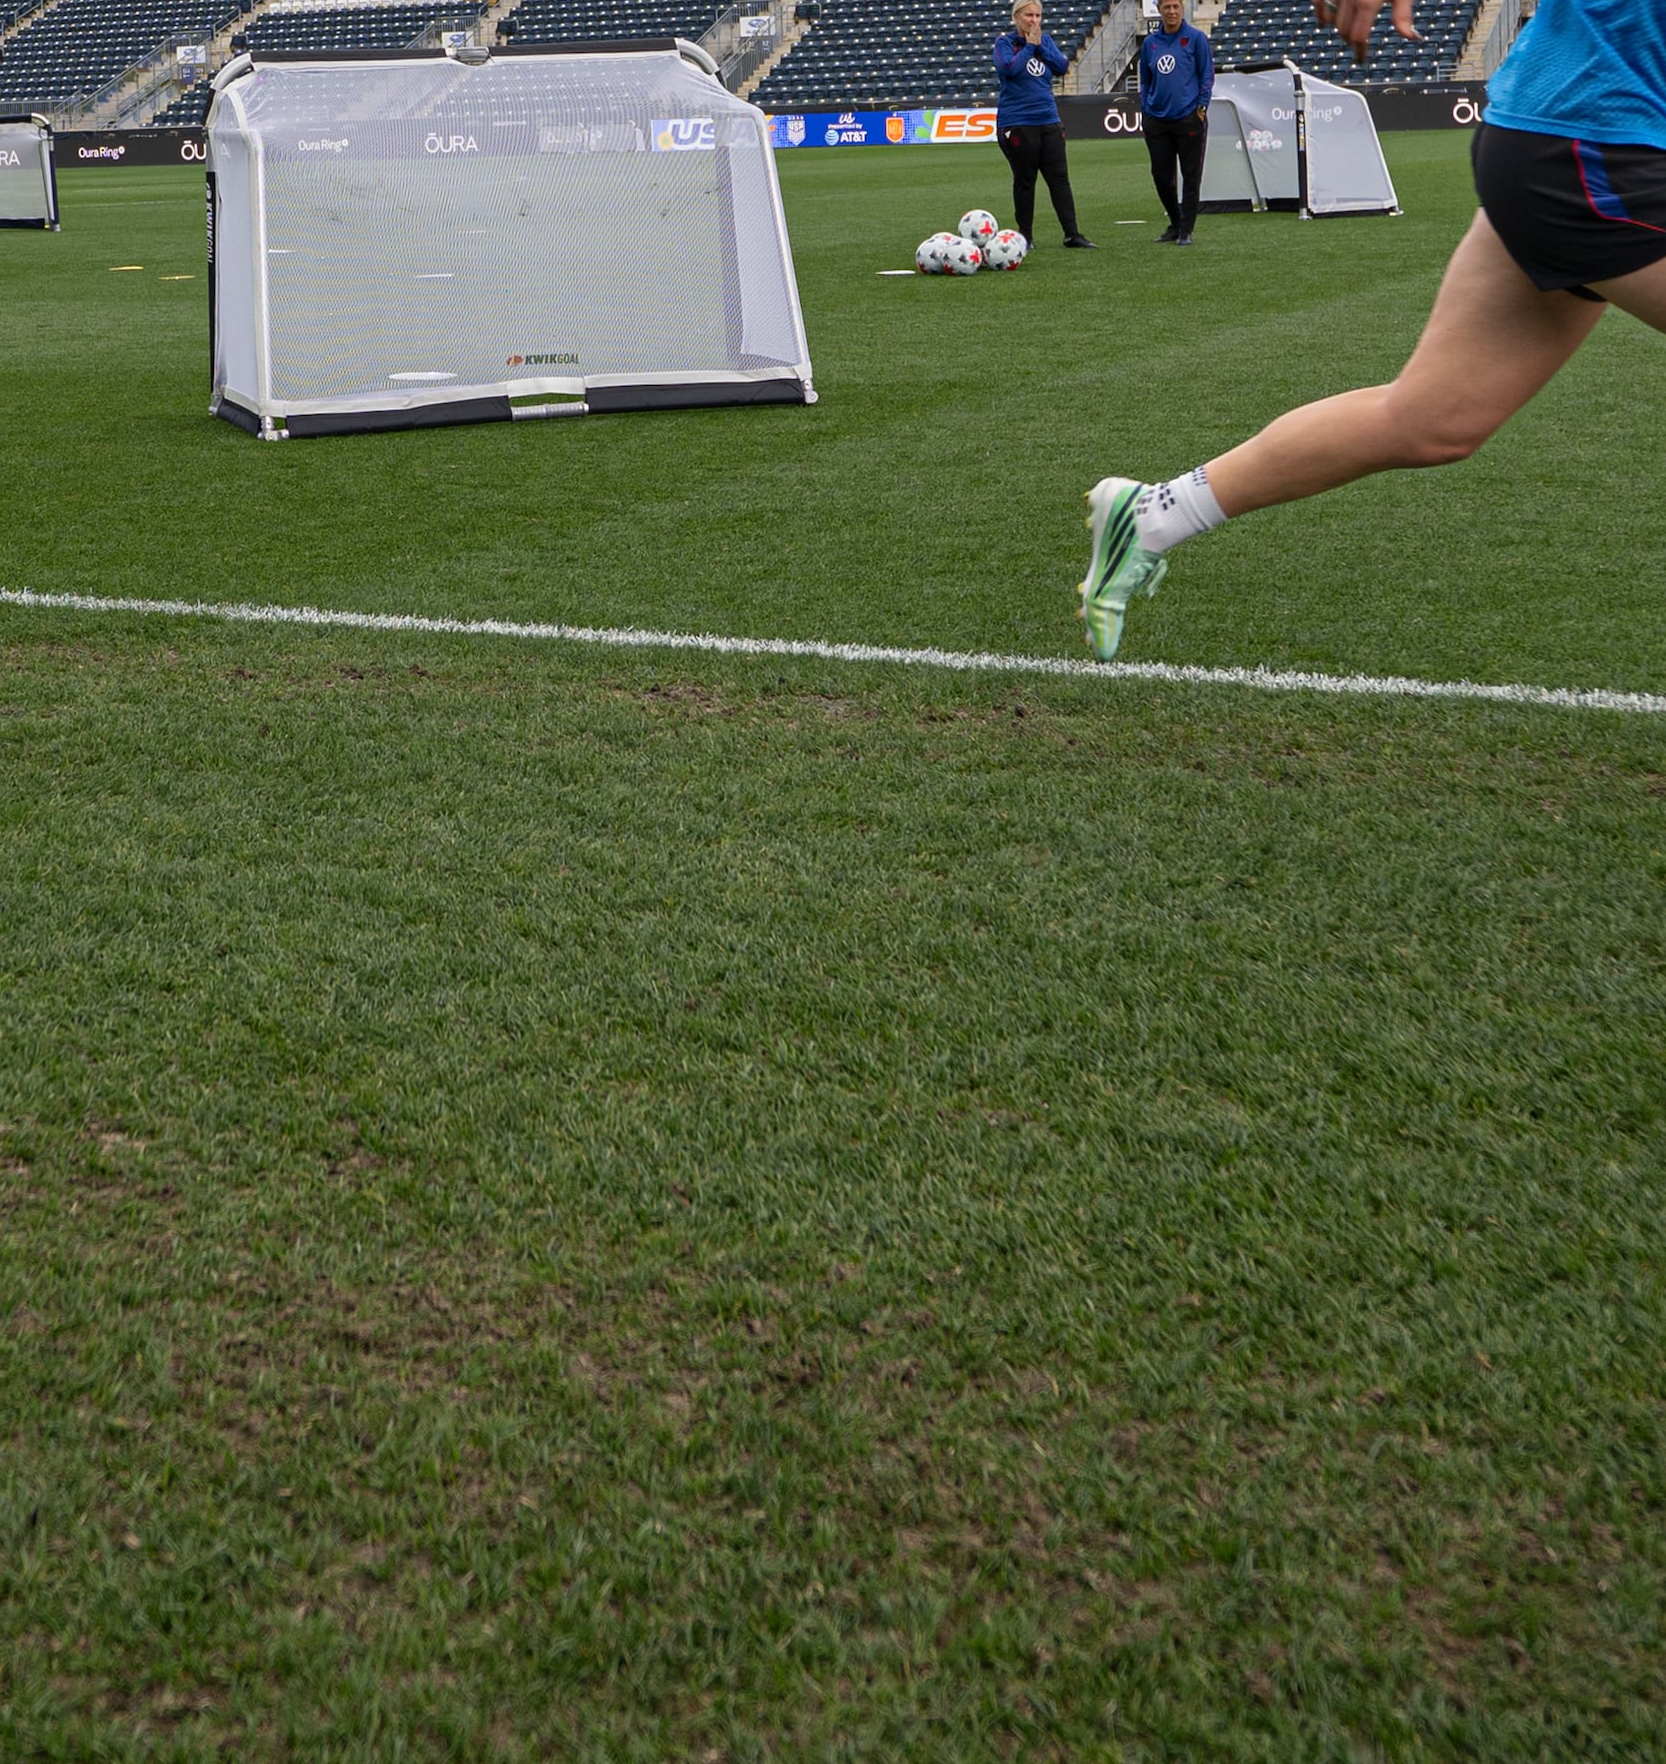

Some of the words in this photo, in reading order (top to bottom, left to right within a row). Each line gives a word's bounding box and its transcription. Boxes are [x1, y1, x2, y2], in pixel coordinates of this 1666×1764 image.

[1271, 107, 1296, 121] Our
[935, 113, 998, 138] ES
[840, 130, 867, 143] AT&T
[298, 138, 321, 151] Oura
[321, 138, 343, 153] Ring
[78, 147, 99, 159] Oura
[99, 146, 119, 160] Ring
